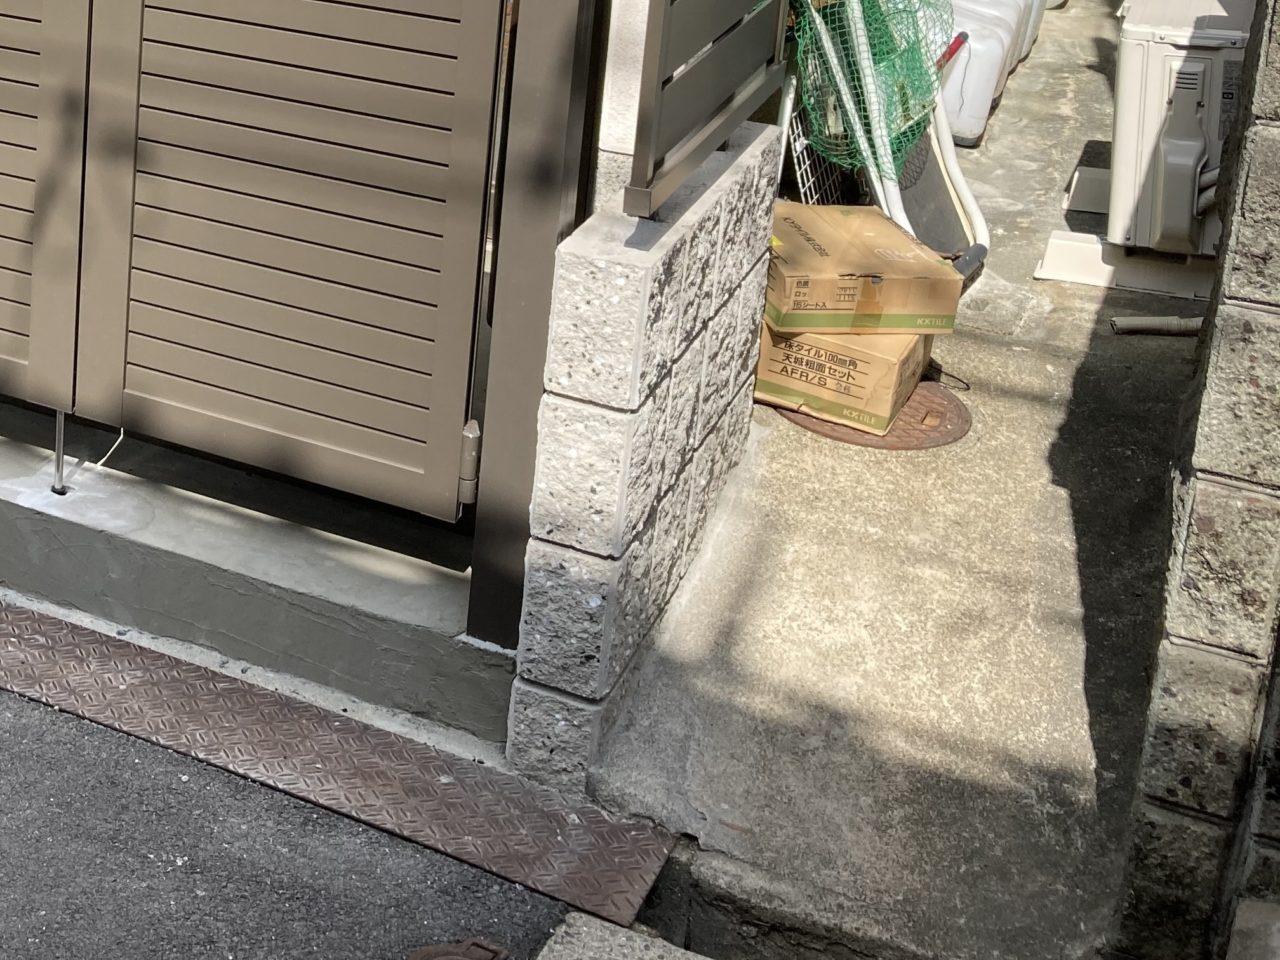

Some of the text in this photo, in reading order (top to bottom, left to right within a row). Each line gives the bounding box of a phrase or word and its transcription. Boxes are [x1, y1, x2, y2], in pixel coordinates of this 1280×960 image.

[780, 365, 828, 387] AFR/S
[781, 352, 856, 382] 天城粗面セット
